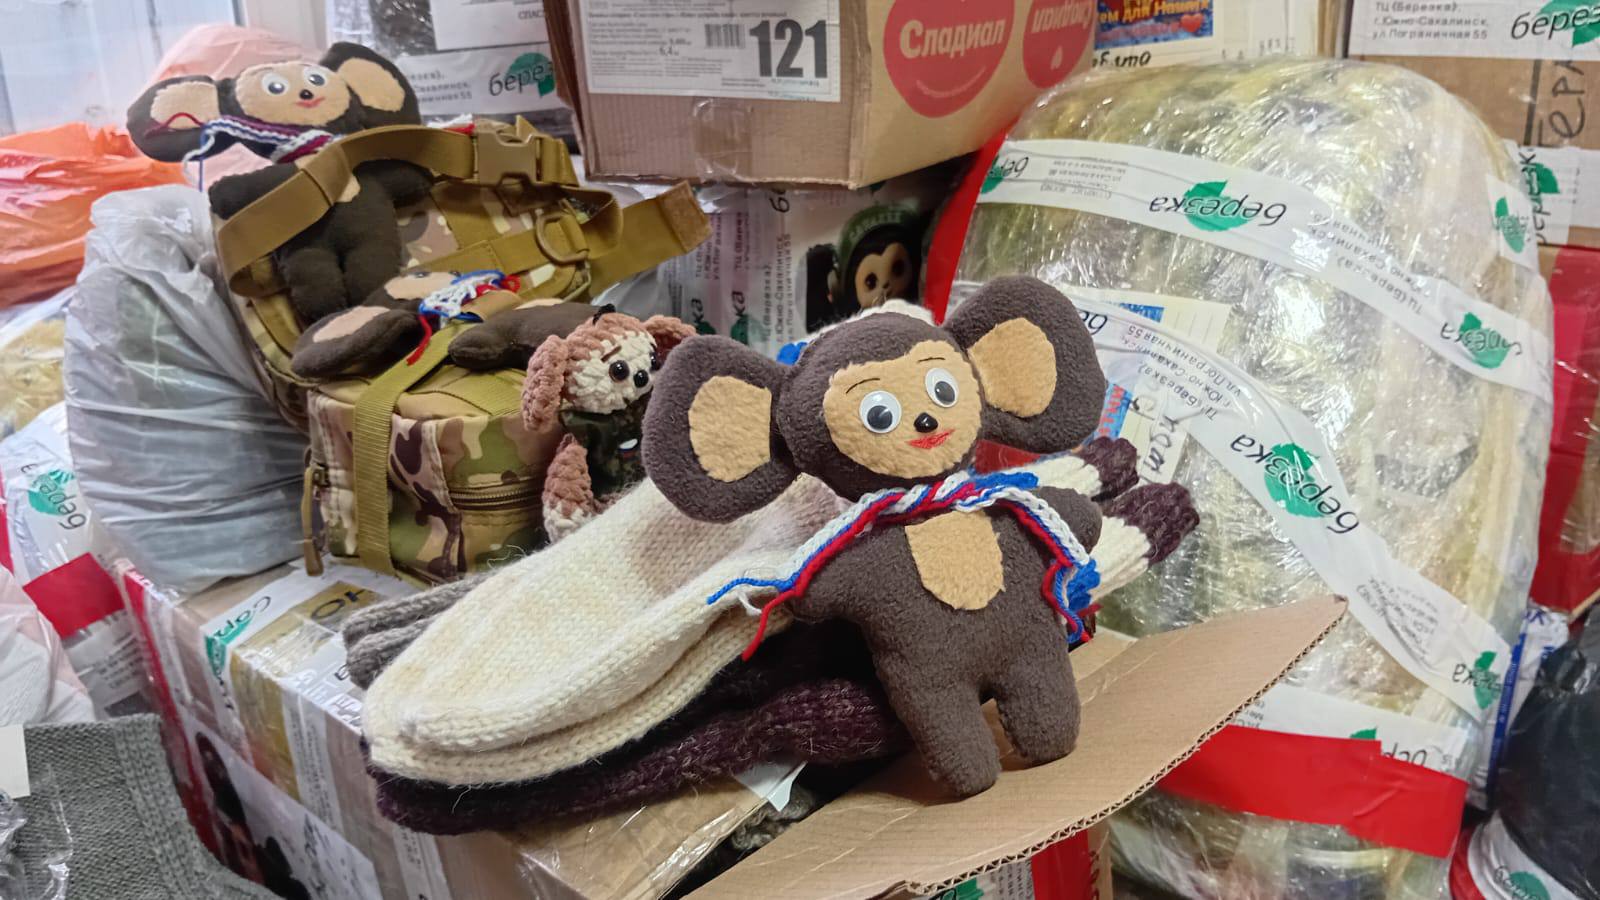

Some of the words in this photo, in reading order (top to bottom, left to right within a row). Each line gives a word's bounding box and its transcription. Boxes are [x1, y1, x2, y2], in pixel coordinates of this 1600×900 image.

[749, 19, 828, 79] 121
[900, 18, 1006, 60] Сладиал
[1149, 193, 1287, 227] березка
[1230, 433, 1360, 535] березка
